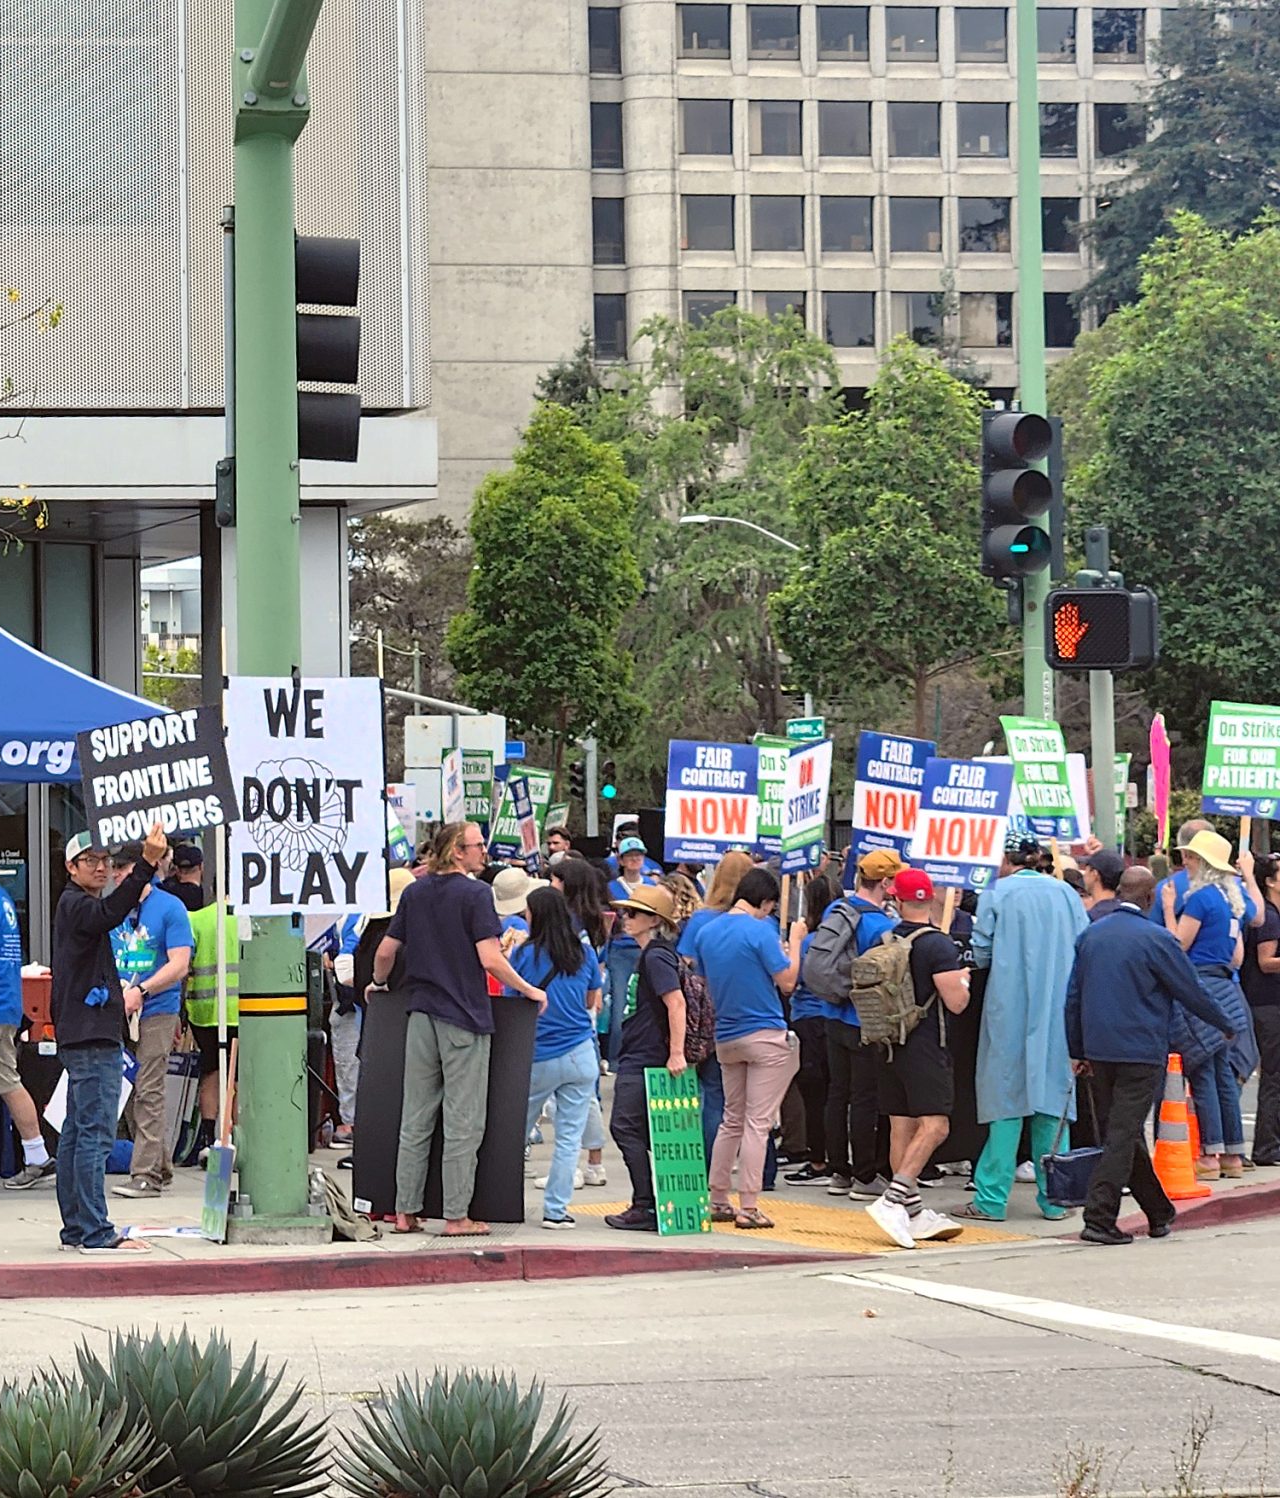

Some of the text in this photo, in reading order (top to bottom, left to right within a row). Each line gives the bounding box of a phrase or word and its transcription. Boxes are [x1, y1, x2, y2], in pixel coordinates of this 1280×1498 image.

[263, 688, 325, 738] WE
[89, 709, 199, 763] SUPPORT
[1219, 721, 1237, 737] On
[696, 746, 733, 769] FAIR
[760, 753, 776, 771] On
[880, 740, 914, 765] FAIR
[1223, 748, 1248, 765] FOR
[92, 755, 214, 807] FRONTLINE
[681, 767, 747, 788] CONTRACT
[798, 757, 815, 788] ON
[867, 760, 925, 786] CONTRACT
[948, 764, 986, 788] FAIR
[242, 776, 363, 823] DON'T
[788, 788, 821, 824] STRIKE
[932, 786, 999, 809] CONTRACT
[97, 795, 224, 847] PROVIDERS
[679, 797, 749, 835] NOW
[925, 818, 999, 857] NOW
[242, 851, 369, 905] PLAY
[651, 1114, 672, 1133] YOU
[654, 1143, 703, 1161] OPERATE
[657, 1174, 705, 1192] WITHOUT
